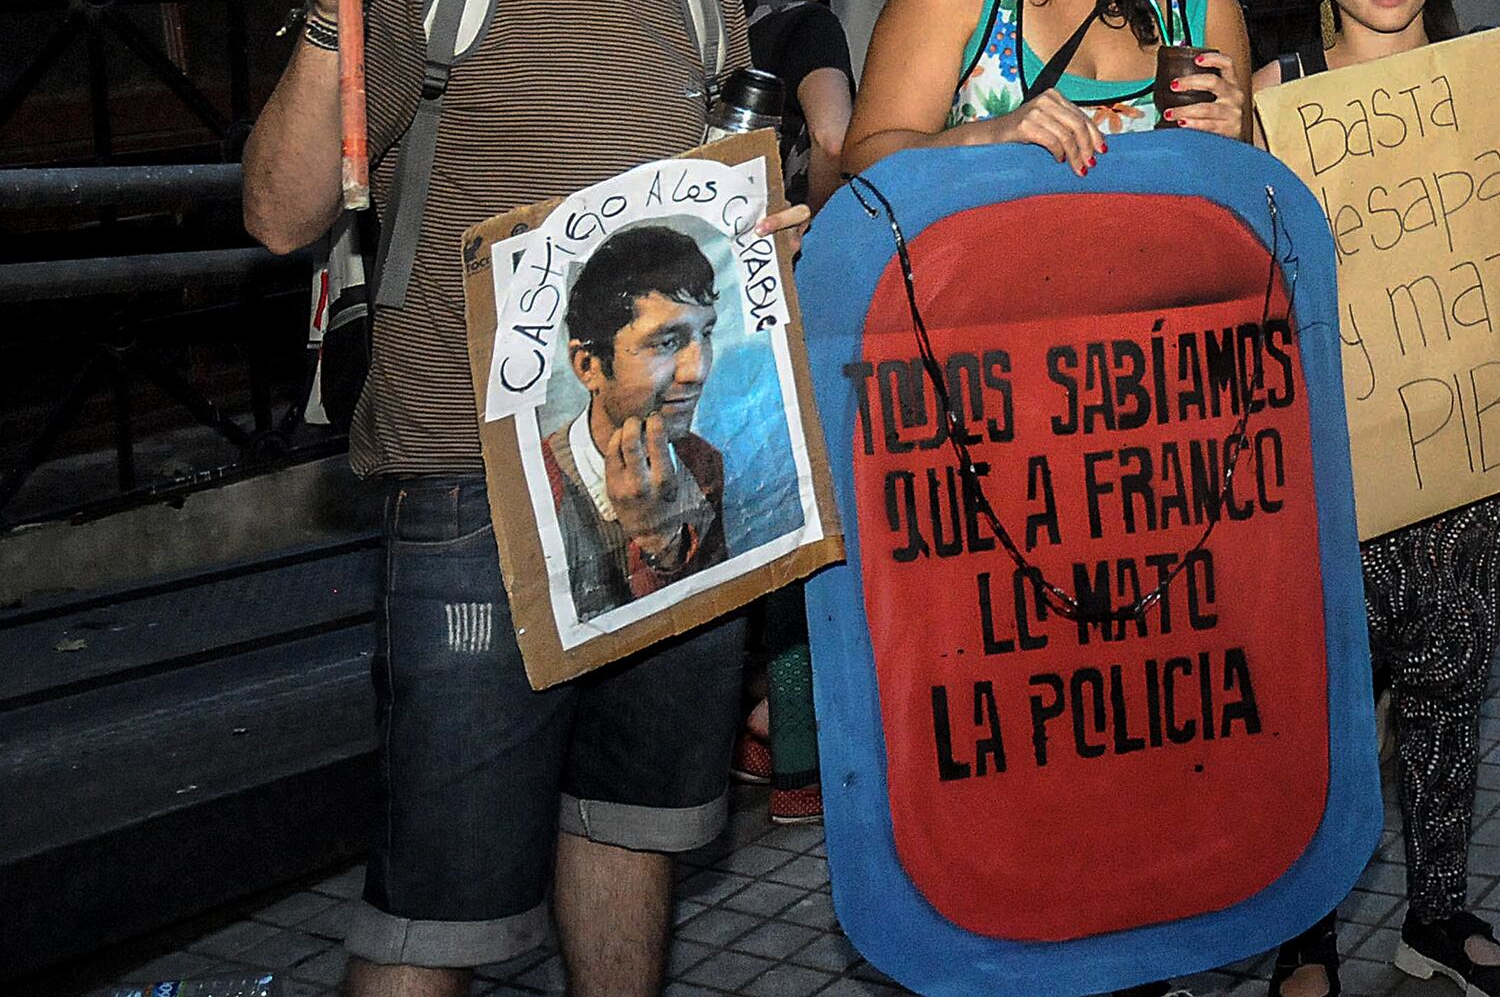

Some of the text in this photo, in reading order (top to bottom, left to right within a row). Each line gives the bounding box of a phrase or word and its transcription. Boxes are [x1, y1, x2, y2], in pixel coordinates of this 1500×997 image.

[646, 170, 663, 207] A
[842, 319, 1296, 456] TODOS SABÍAMOS
[1339, 303, 1376, 402] y
[883, 428, 1285, 564] QUE A FRANCO
[977, 548, 1219, 656] LO MATO
[931, 647, 1263, 783] LA POLICIA
